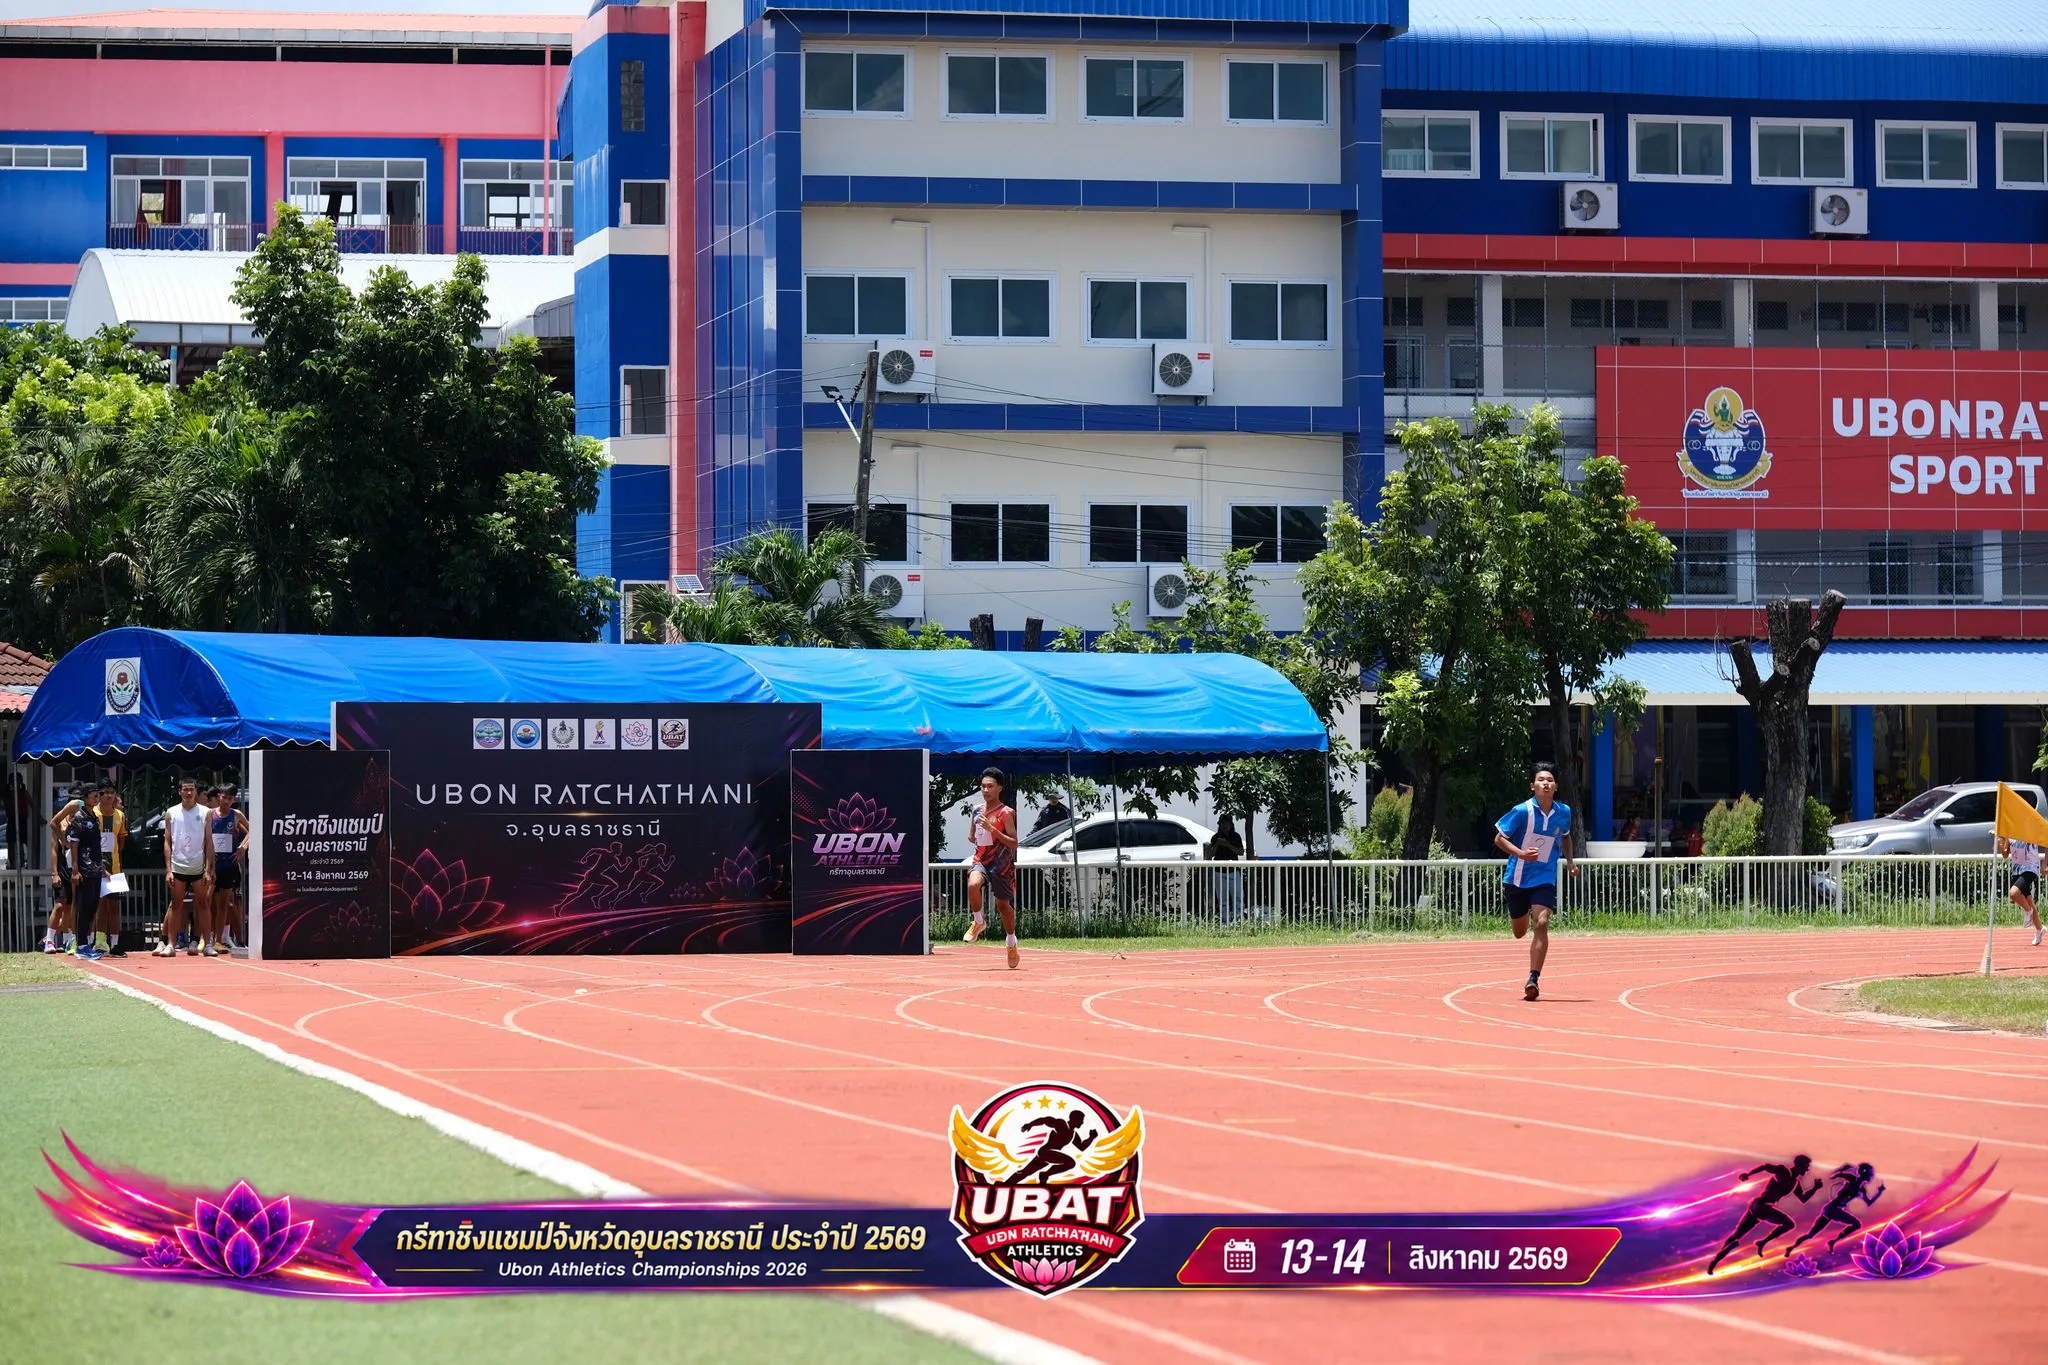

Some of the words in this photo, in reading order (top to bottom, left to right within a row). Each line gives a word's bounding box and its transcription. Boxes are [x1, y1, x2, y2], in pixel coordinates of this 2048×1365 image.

[1832, 397, 2048, 440] UBONRA
[416, 783, 516, 805] UBON
[534, 783, 752, 805] RATCHATHANI
[271, 813, 384, 836] กรีฑาชิงแชมป์
[506, 819, 660, 842] จ.อุบลราชธานี
[285, 837, 368, 856] จ.อุบลราชธานี
[812, 832, 907, 854] UBON
[818, 854, 902, 866] ATHLETICS
[315, 870, 346, 880] สิงหาคม
[348, 870, 369, 880] 2569
